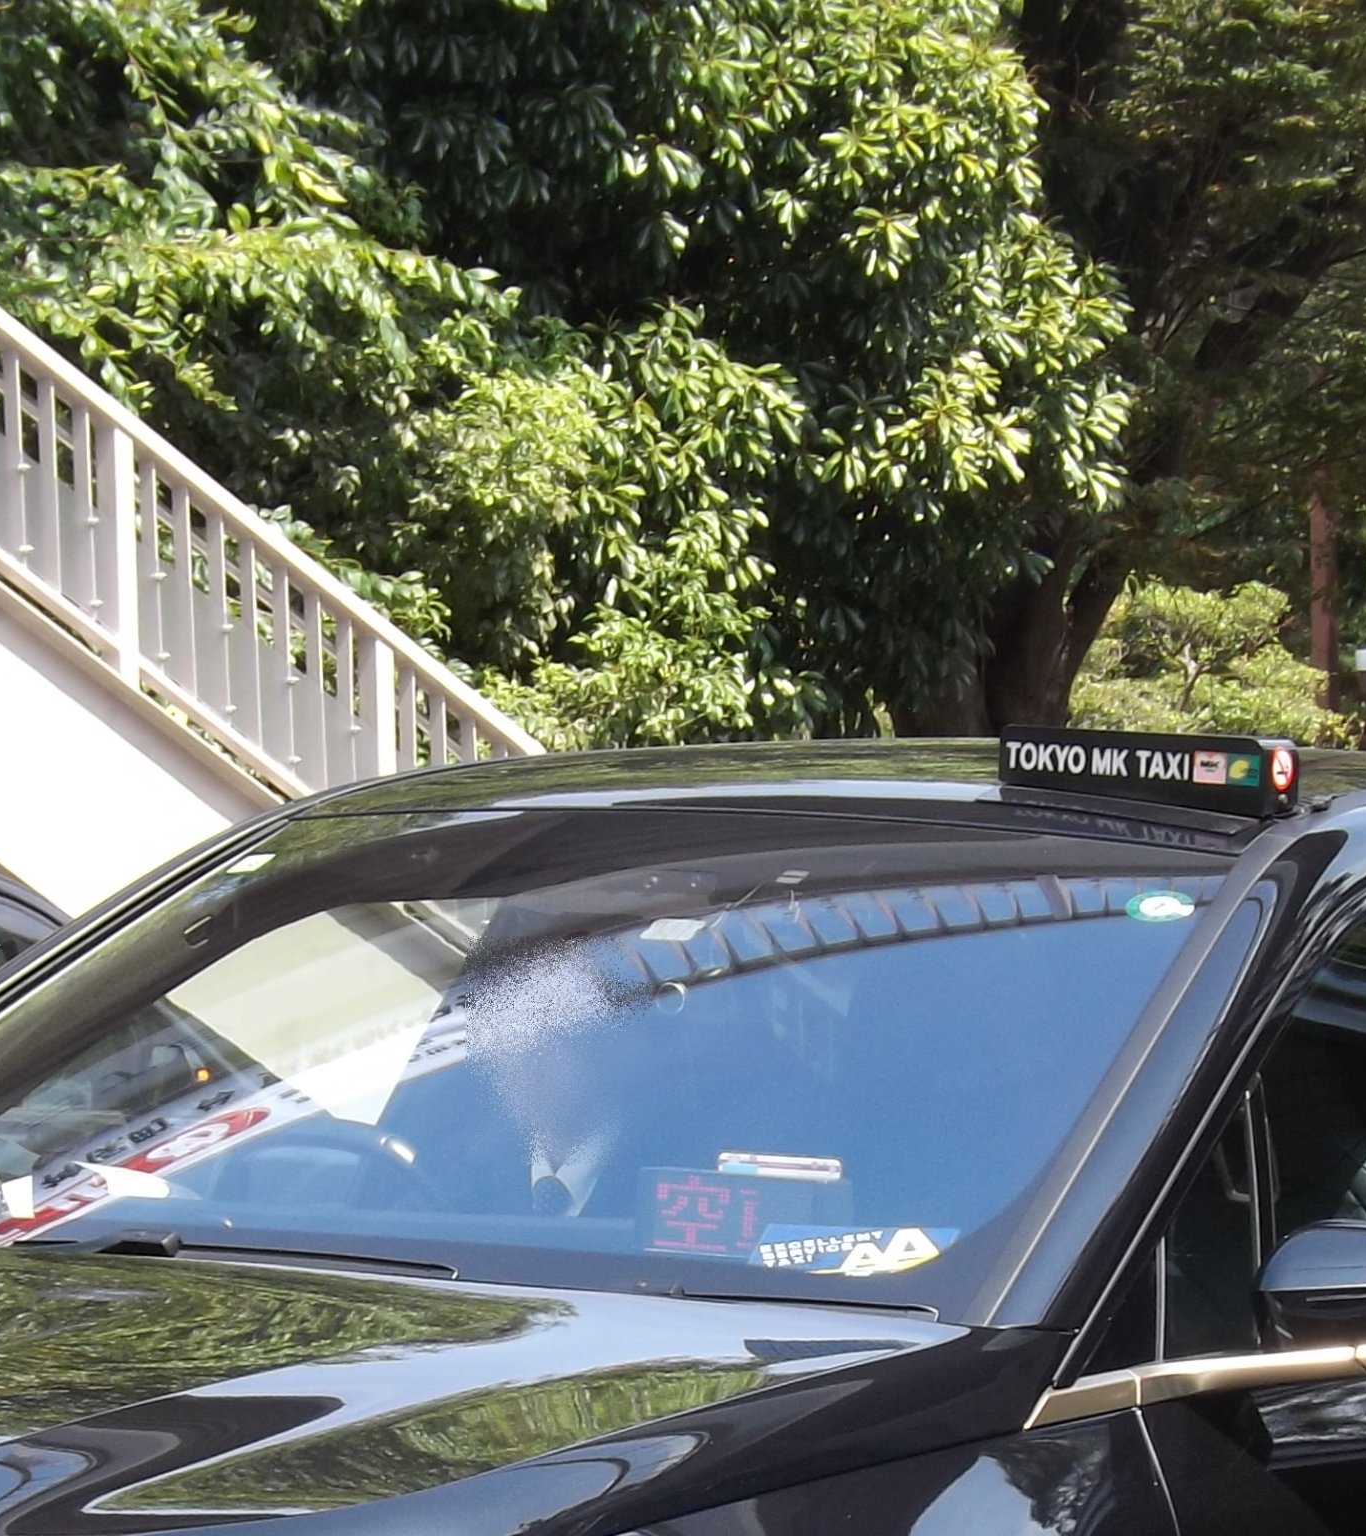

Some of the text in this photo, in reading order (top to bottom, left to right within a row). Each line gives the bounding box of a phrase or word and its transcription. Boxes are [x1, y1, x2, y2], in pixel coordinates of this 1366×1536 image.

[1006, 741, 1190, 781] TOKYO MK TAXI
[759, 1230, 884, 1253] EXCELLENT
